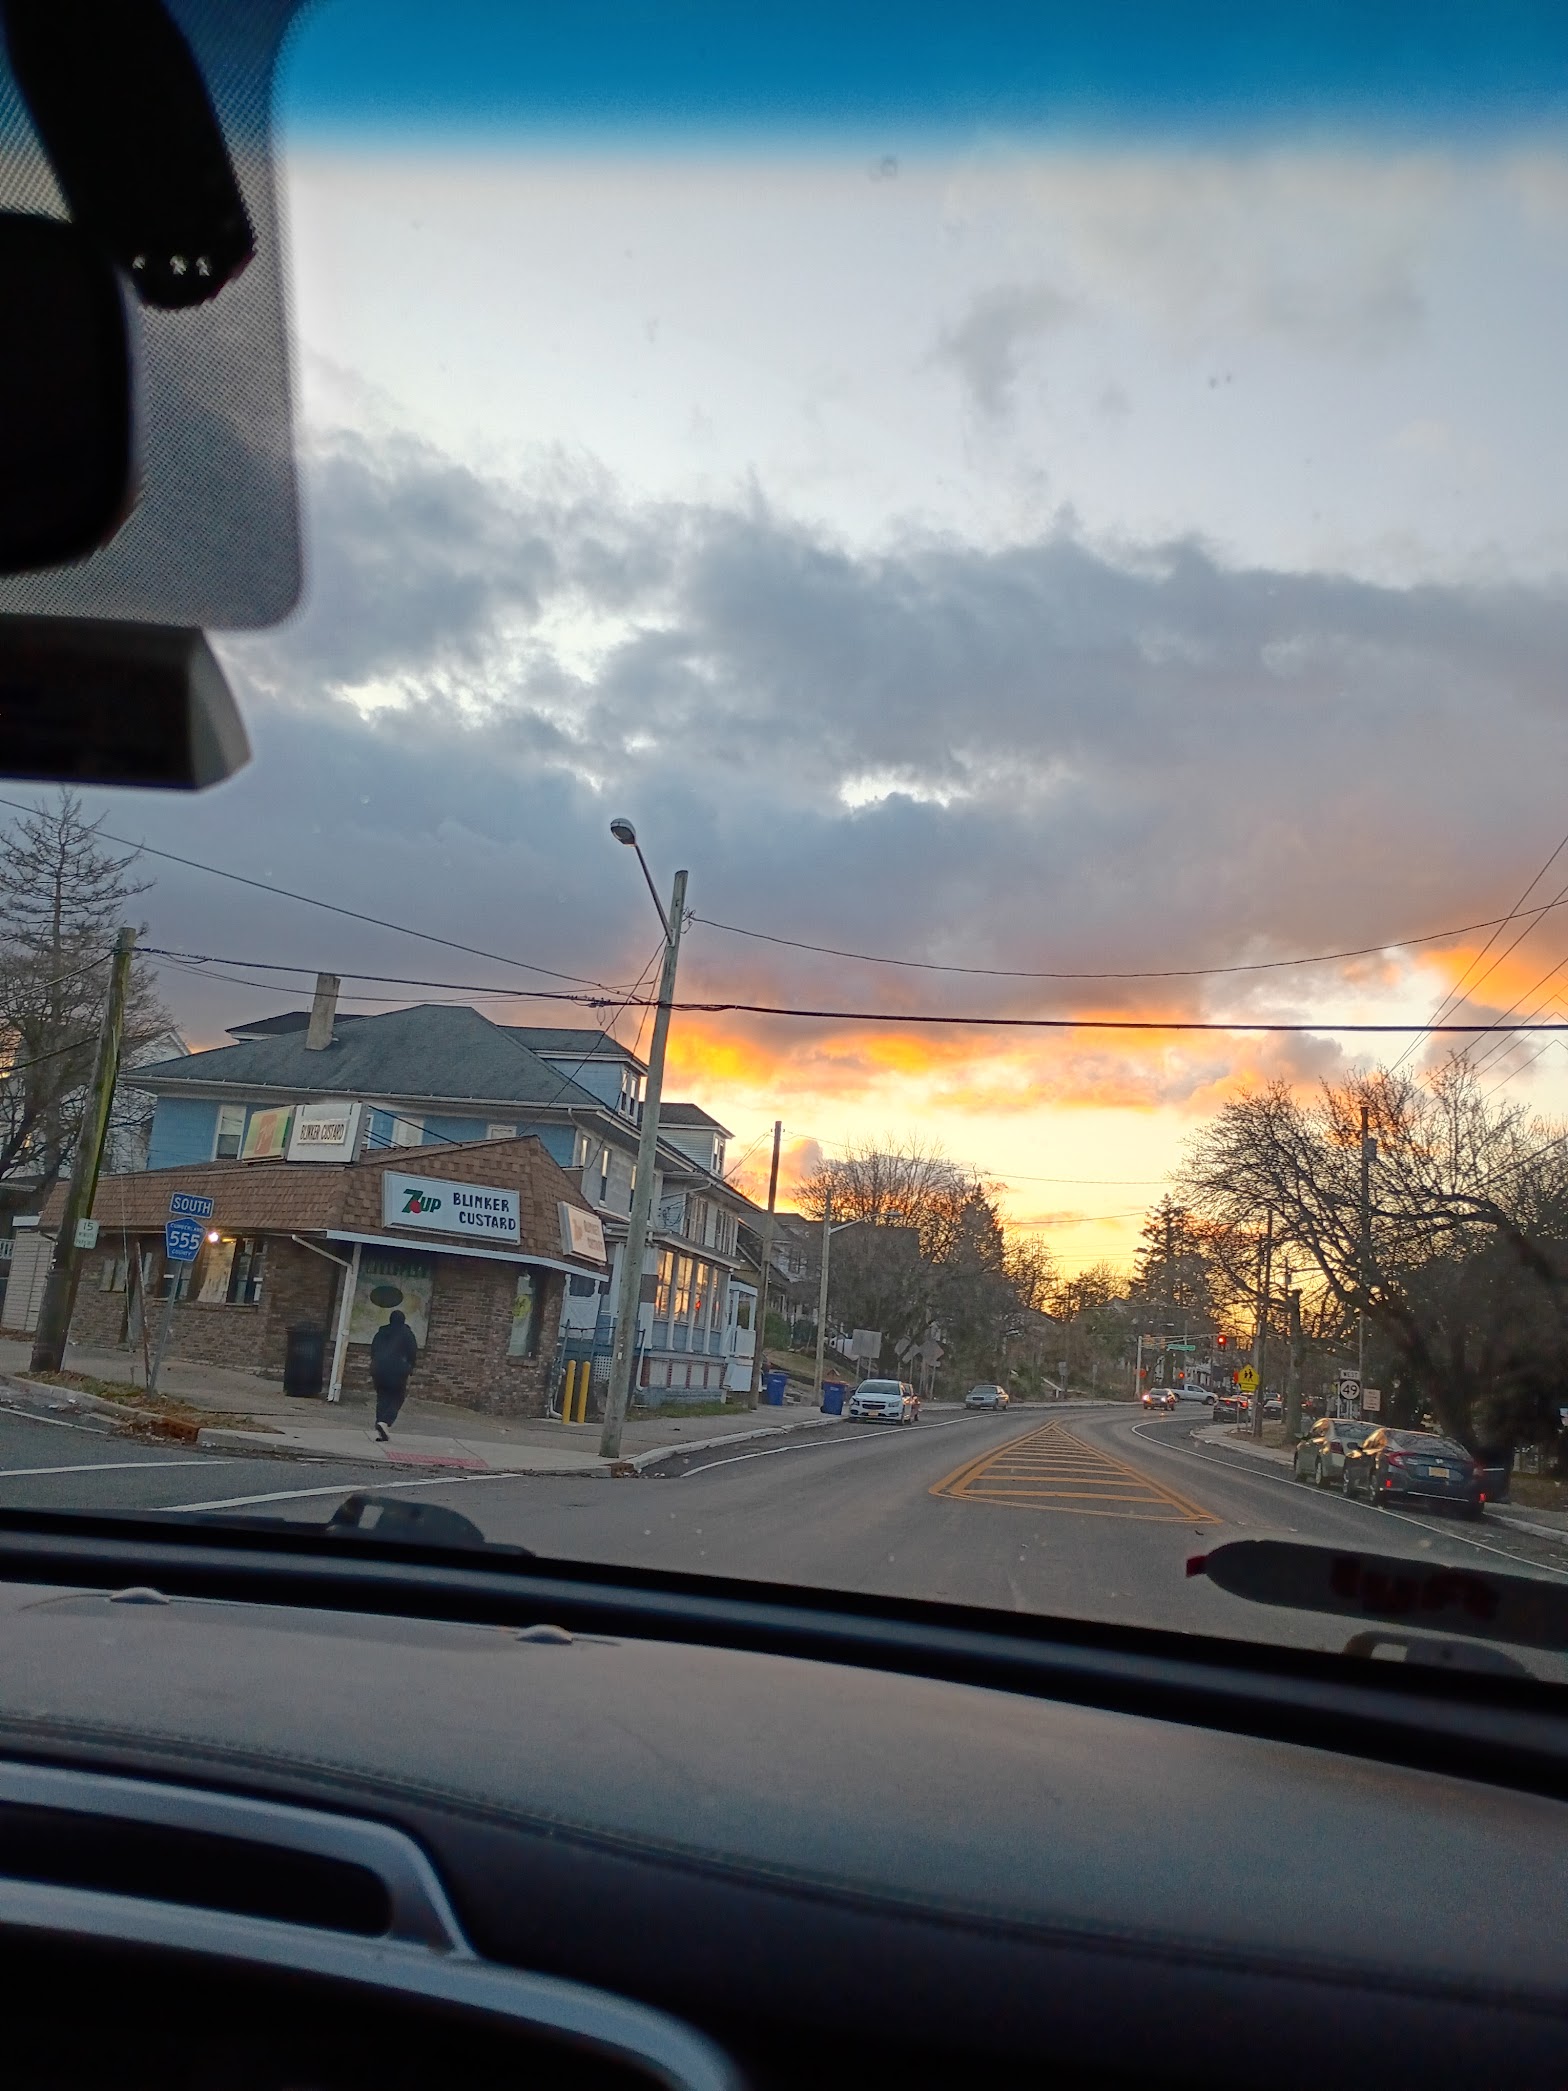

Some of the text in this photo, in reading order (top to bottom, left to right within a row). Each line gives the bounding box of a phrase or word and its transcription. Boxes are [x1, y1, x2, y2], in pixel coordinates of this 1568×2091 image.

[300, 1123, 345, 1141] BLINKER CUSTARD
[173, 1197, 212, 1214] SOUTH
[453, 1192, 510, 1213] BLINKER
[83, 1221, 94, 1231] 15
[459, 1211, 516, 1231] CUSTARD
[169, 1231, 201, 1250] 555
[1342, 1384, 1358, 1396] 49
